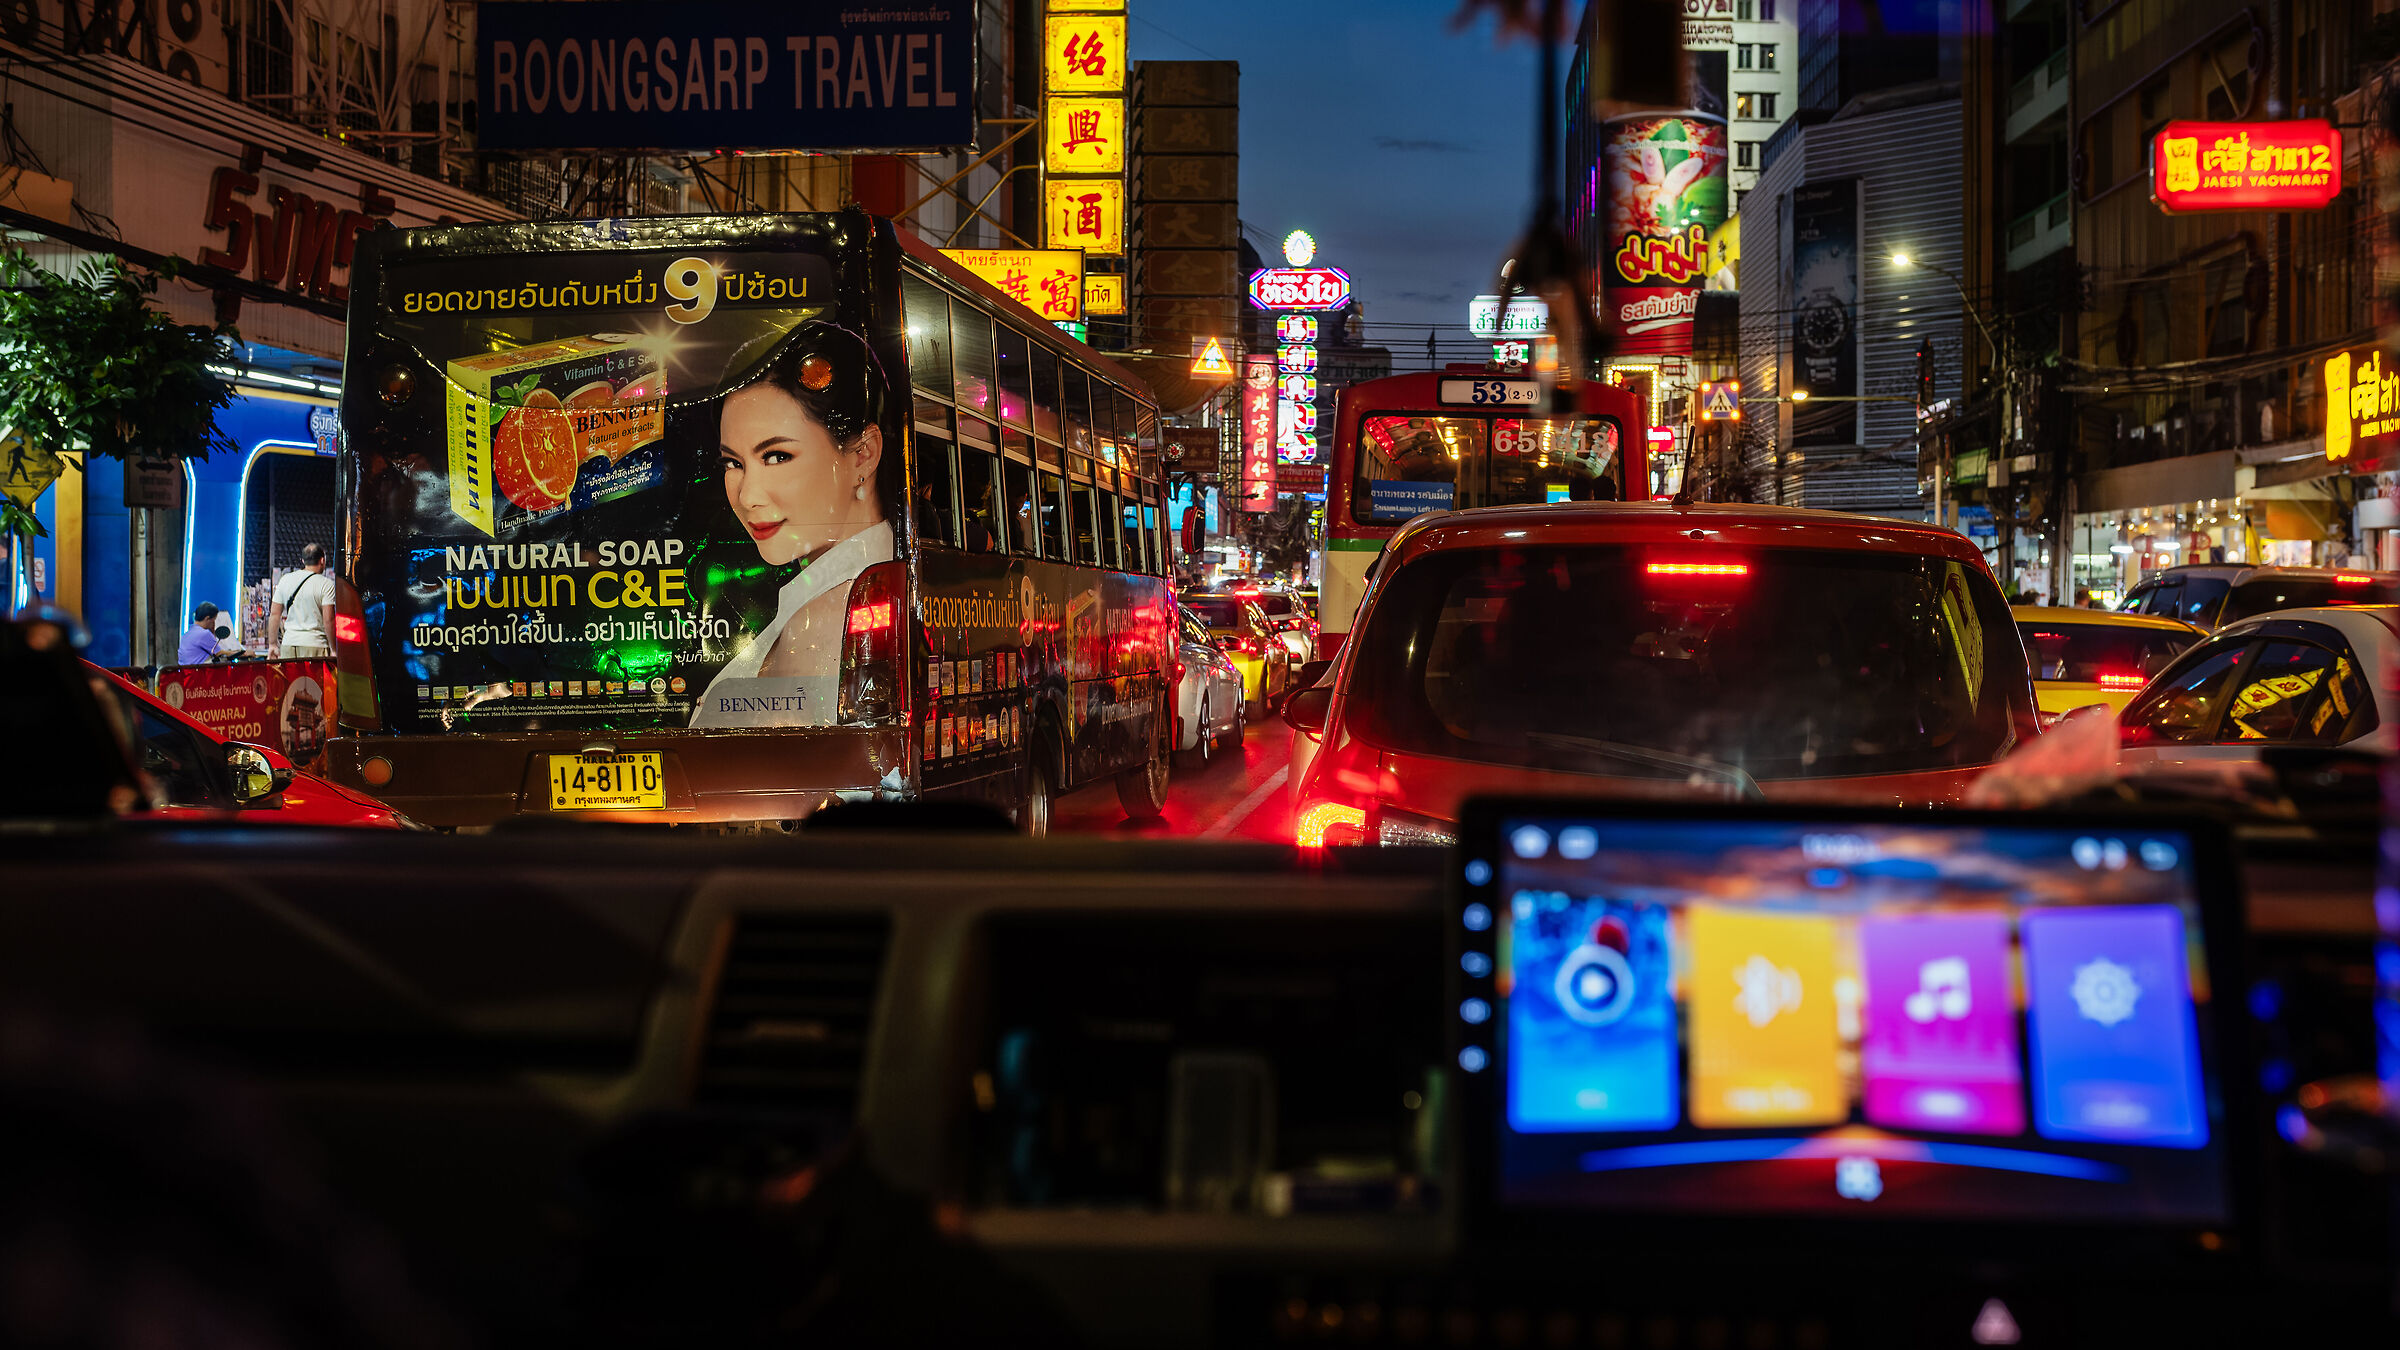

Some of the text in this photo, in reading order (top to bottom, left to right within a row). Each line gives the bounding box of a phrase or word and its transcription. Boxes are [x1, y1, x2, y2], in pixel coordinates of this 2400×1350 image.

[493, 33, 957, 114] ROONGSARP TRAVEL
[2202, 173, 2330, 188] JAESI YAOWARAT
[403, 256, 808, 325] ยอดขายอันดับหนึ่ง 9 ปีซ้อน
[564, 364, 604, 381] Vitamin
[606, 360, 615, 372] C
[617, 358, 625, 370] &
[628, 355, 636, 367] E
[1472, 381, 1538, 404] 53 (2-9)
[576, 398, 664, 434] BENNETT
[588, 420, 655, 447] Natural extracts
[1251, 390, 1271, 502] 北京同仁堂
[500, 503, 566, 530] Handmade Product
[445, 538, 685, 571] NATURAL SOAP
[446, 568, 686, 610] เบนเนท C&E
[923, 580, 1020, 629] ยอดขายอันดับหนึ่ง
[1020, 575, 1035, 648] 9
[413, 609, 731, 653] ผิวดูสว่างใสขึ้น...อย่างเห็นได้ชัด
[189, 706, 246, 723] YAOWARAJ
[719, 694, 805, 714] BENNETT
[228, 722, 262, 739] FOOD
[574, 755, 653, 764] THAILAND 01
[560, 765, 657, 792] 14-8110
[574, 796, 641, 807] กรุงเทพมหานคร
